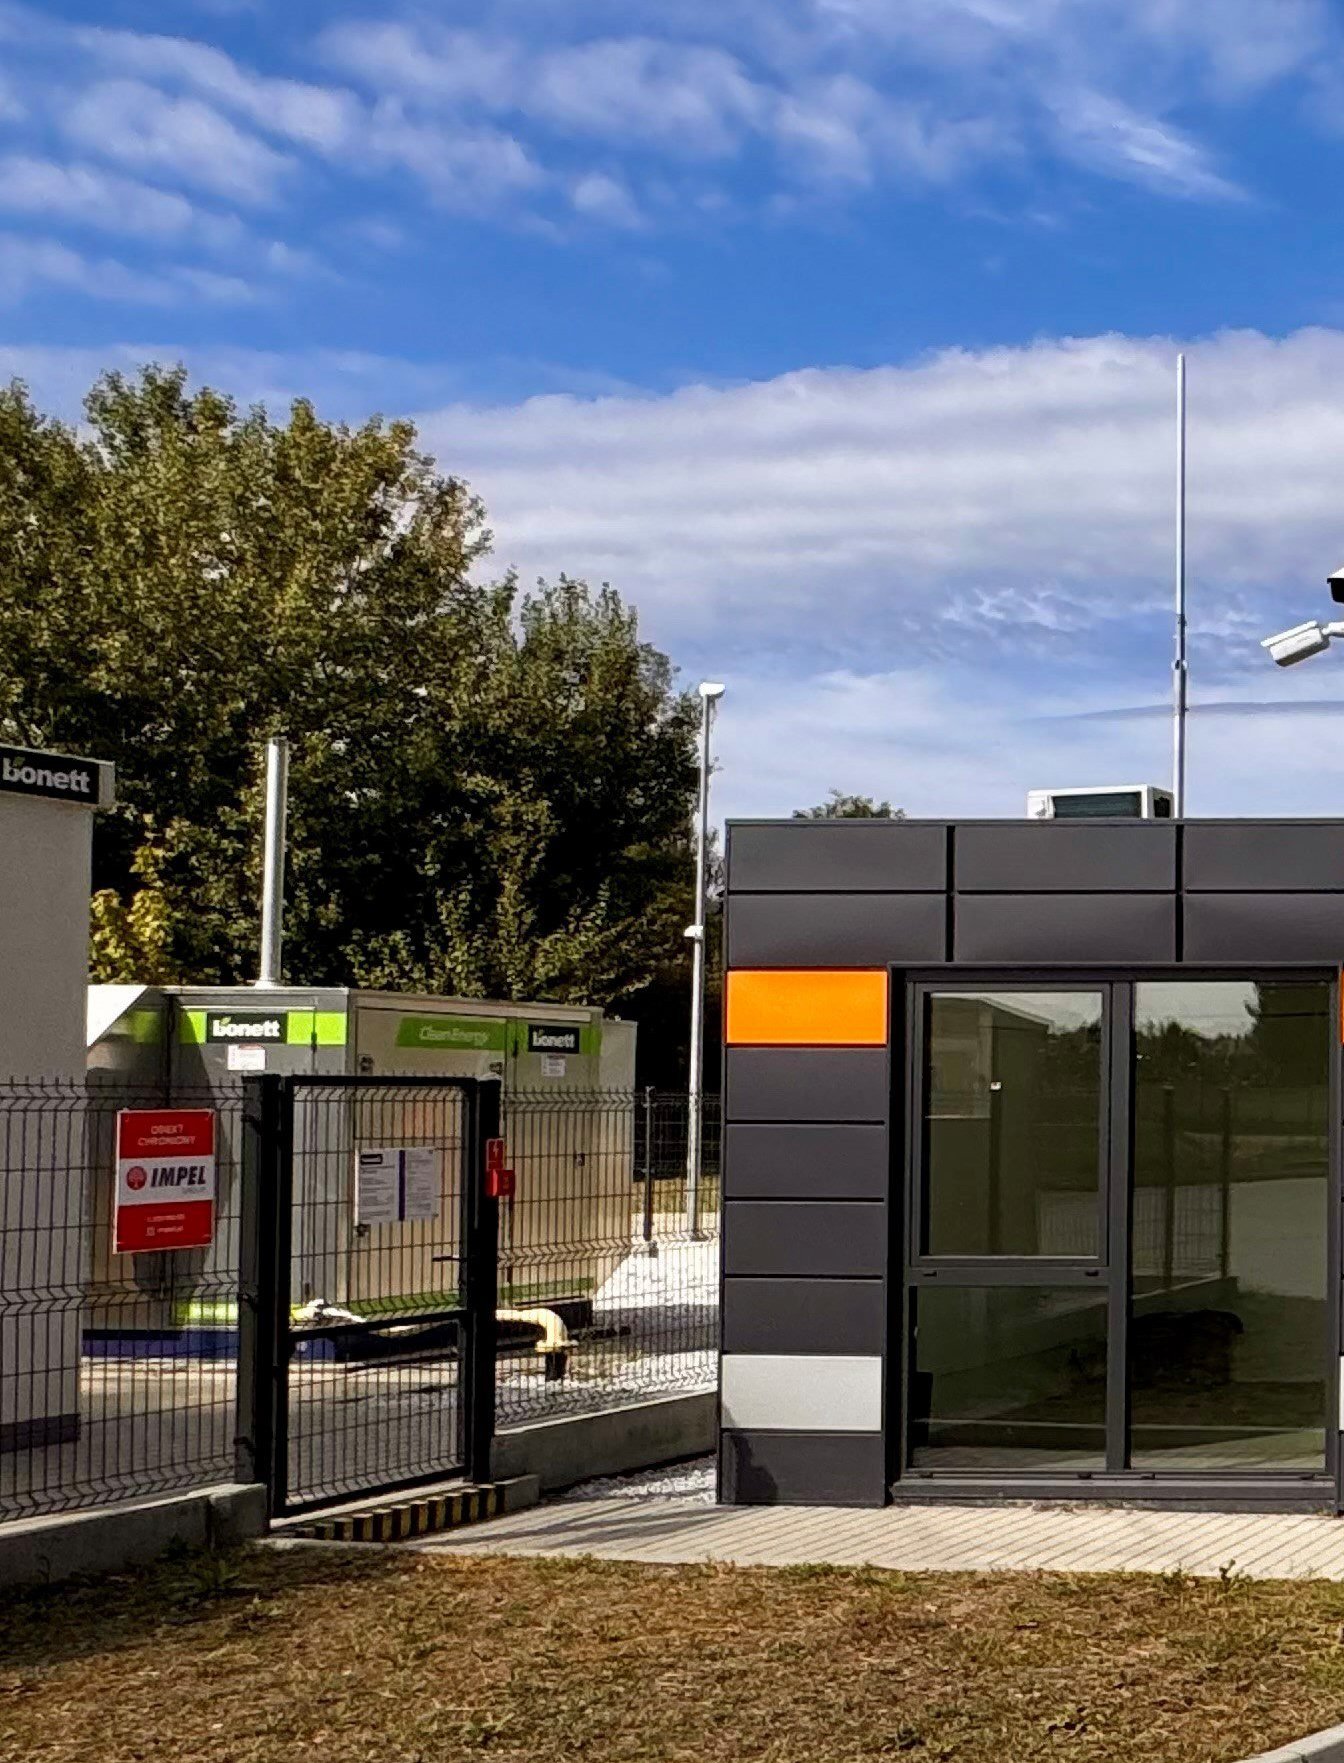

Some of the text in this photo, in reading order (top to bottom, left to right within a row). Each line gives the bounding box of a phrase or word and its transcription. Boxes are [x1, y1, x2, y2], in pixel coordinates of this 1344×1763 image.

[3, 757, 90, 793] bonett
[212, 1019, 280, 1037] bonett
[150, 1165, 206, 1188] IMPEL
